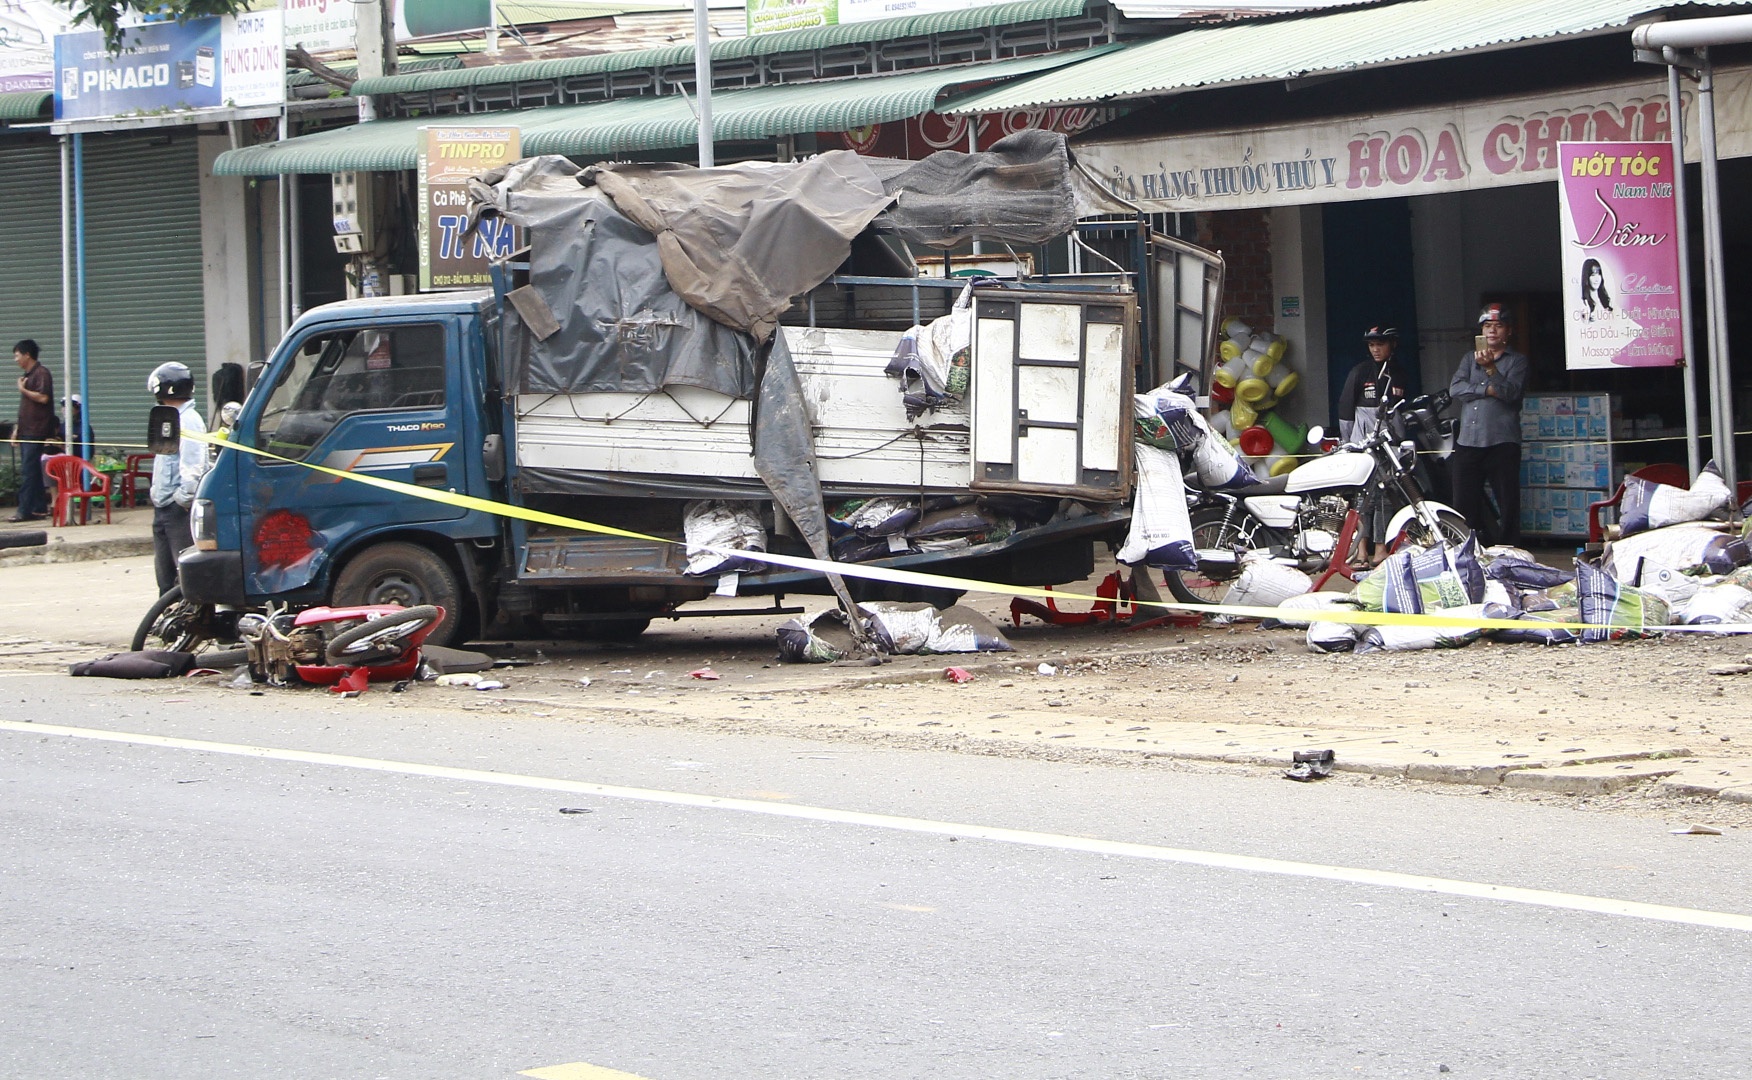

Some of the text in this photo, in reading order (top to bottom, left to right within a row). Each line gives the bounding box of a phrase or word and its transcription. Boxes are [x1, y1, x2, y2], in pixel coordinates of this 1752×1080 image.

[83, 63, 170, 94] PINACO
[439, 142, 507, 160] TINPRO
[1346, 126, 1469, 190] HOA
[1571, 150, 1662, 178] HỚT TÓC
[1142, 161, 1199, 202] HÀNG
[1200, 147, 1270, 197] THUỐC
[1271, 148, 1317, 192] THỦ
[1321, 157, 1337, 189] Y
[433, 190, 467, 206] Cà Phê
[1613, 182, 1673, 199] Nam Nữ
[1571, 188, 1667, 250] Diễm
[1648, 306, 1680, 322] Nhuộm
[1580, 327, 1599, 341] Hấp
[1582, 346, 1621, 359] Massage
[386, 424, 420, 432] THACO
